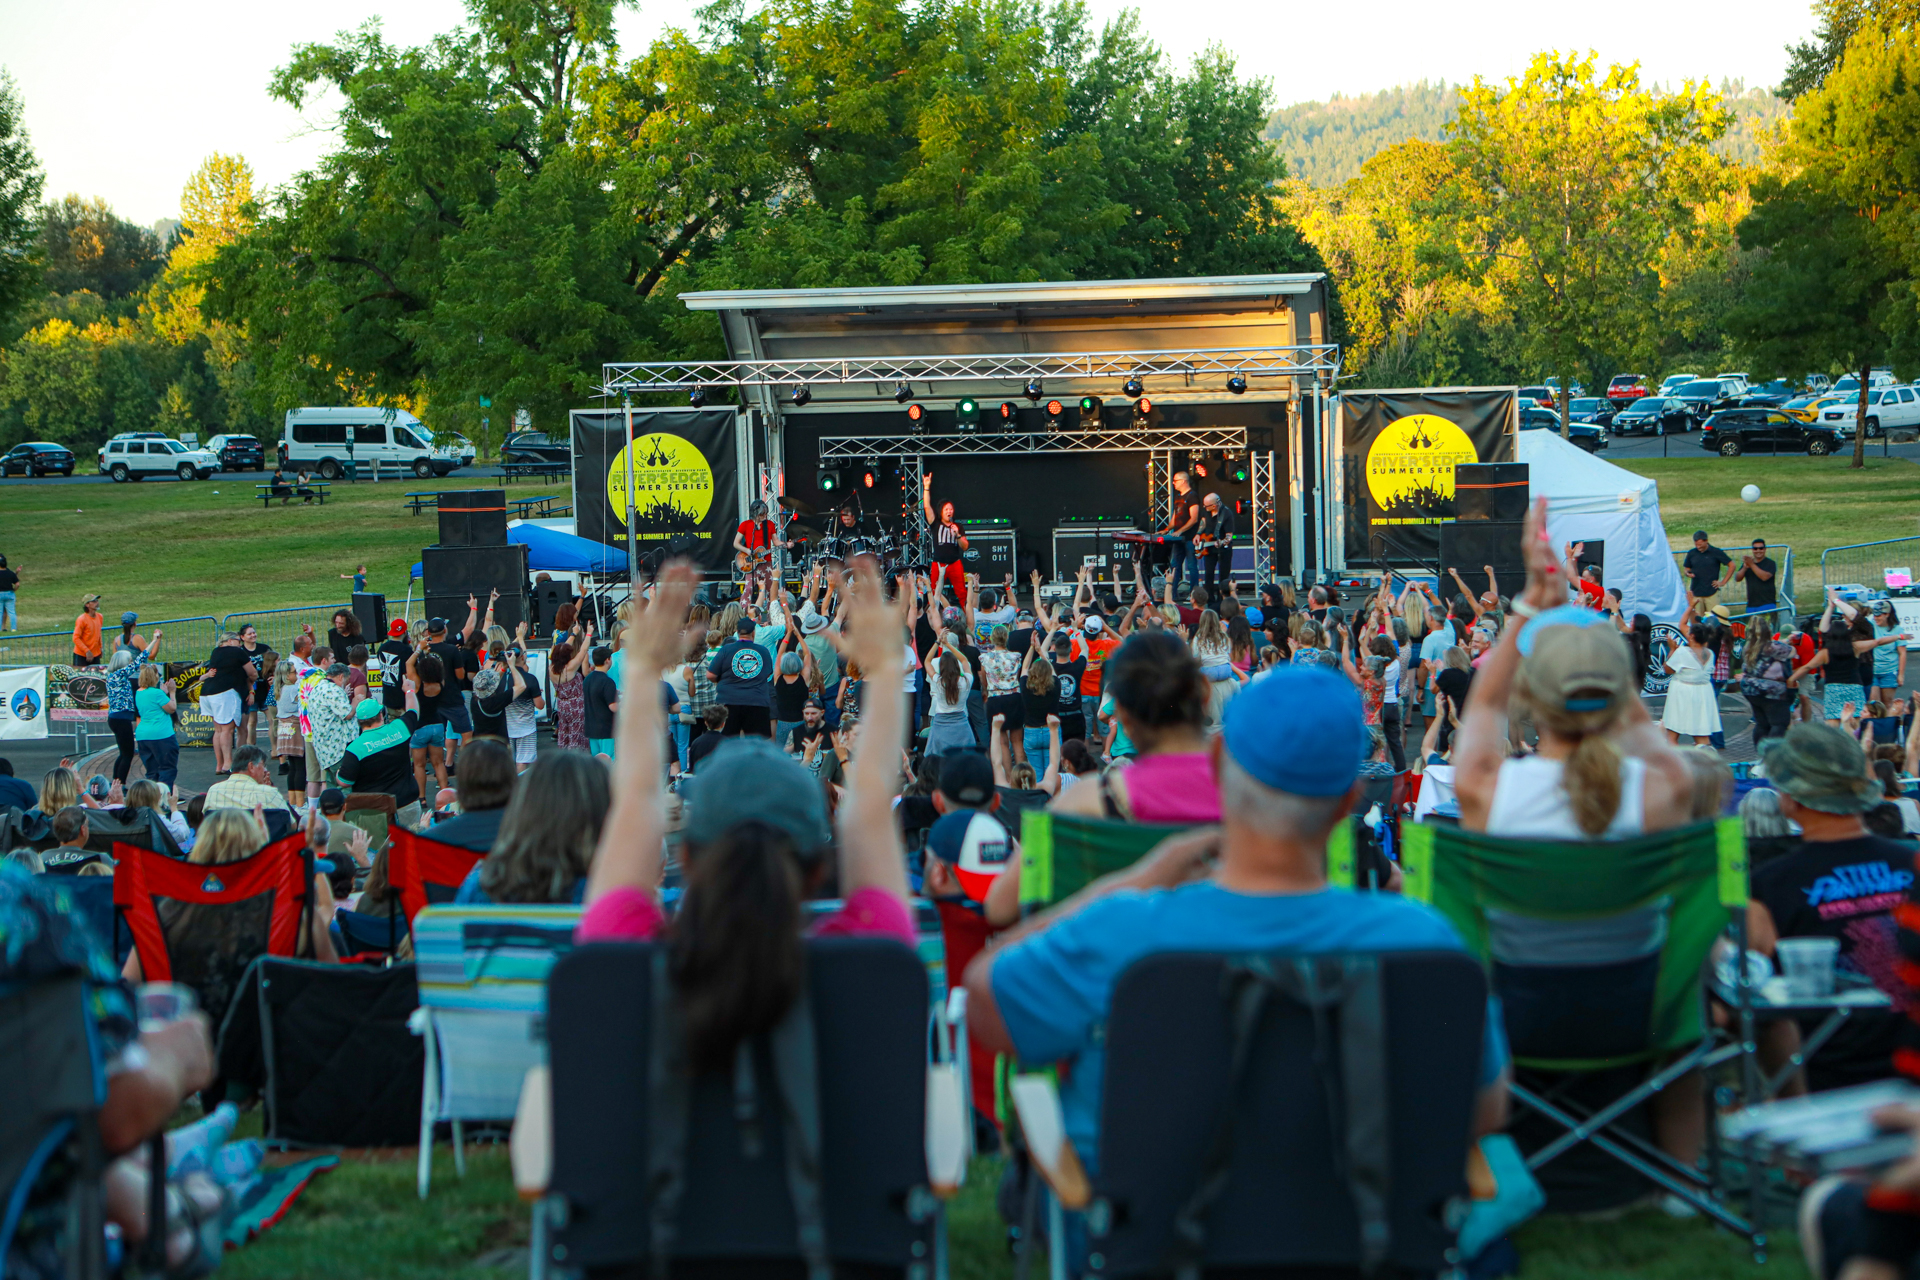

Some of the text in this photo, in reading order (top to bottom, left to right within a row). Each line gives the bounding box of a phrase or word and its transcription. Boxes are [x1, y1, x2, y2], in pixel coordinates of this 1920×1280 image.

[1371, 455, 1431, 468] RIVER'S
[1372, 466, 1452, 475] SUMMER SER
[669, 471, 709, 484] EDGE
[667, 483, 709, 491] SERIES
[1370, 517, 1388, 525] SPEND
[1425, 517, 1432, 525] AT
[613, 533, 628, 541] SPEN
[642, 532, 664, 541] SUMMER
[664, 532, 671, 540] AT
[699, 531, 712, 539] EDGE
[991, 545, 1008, 553] SHY
[1113, 551, 1130, 559] 010
[173, 666, 207, 689] GOLDEN
[368, 673, 382, 683] LES
[363, 731, 403, 753] Disneyland
